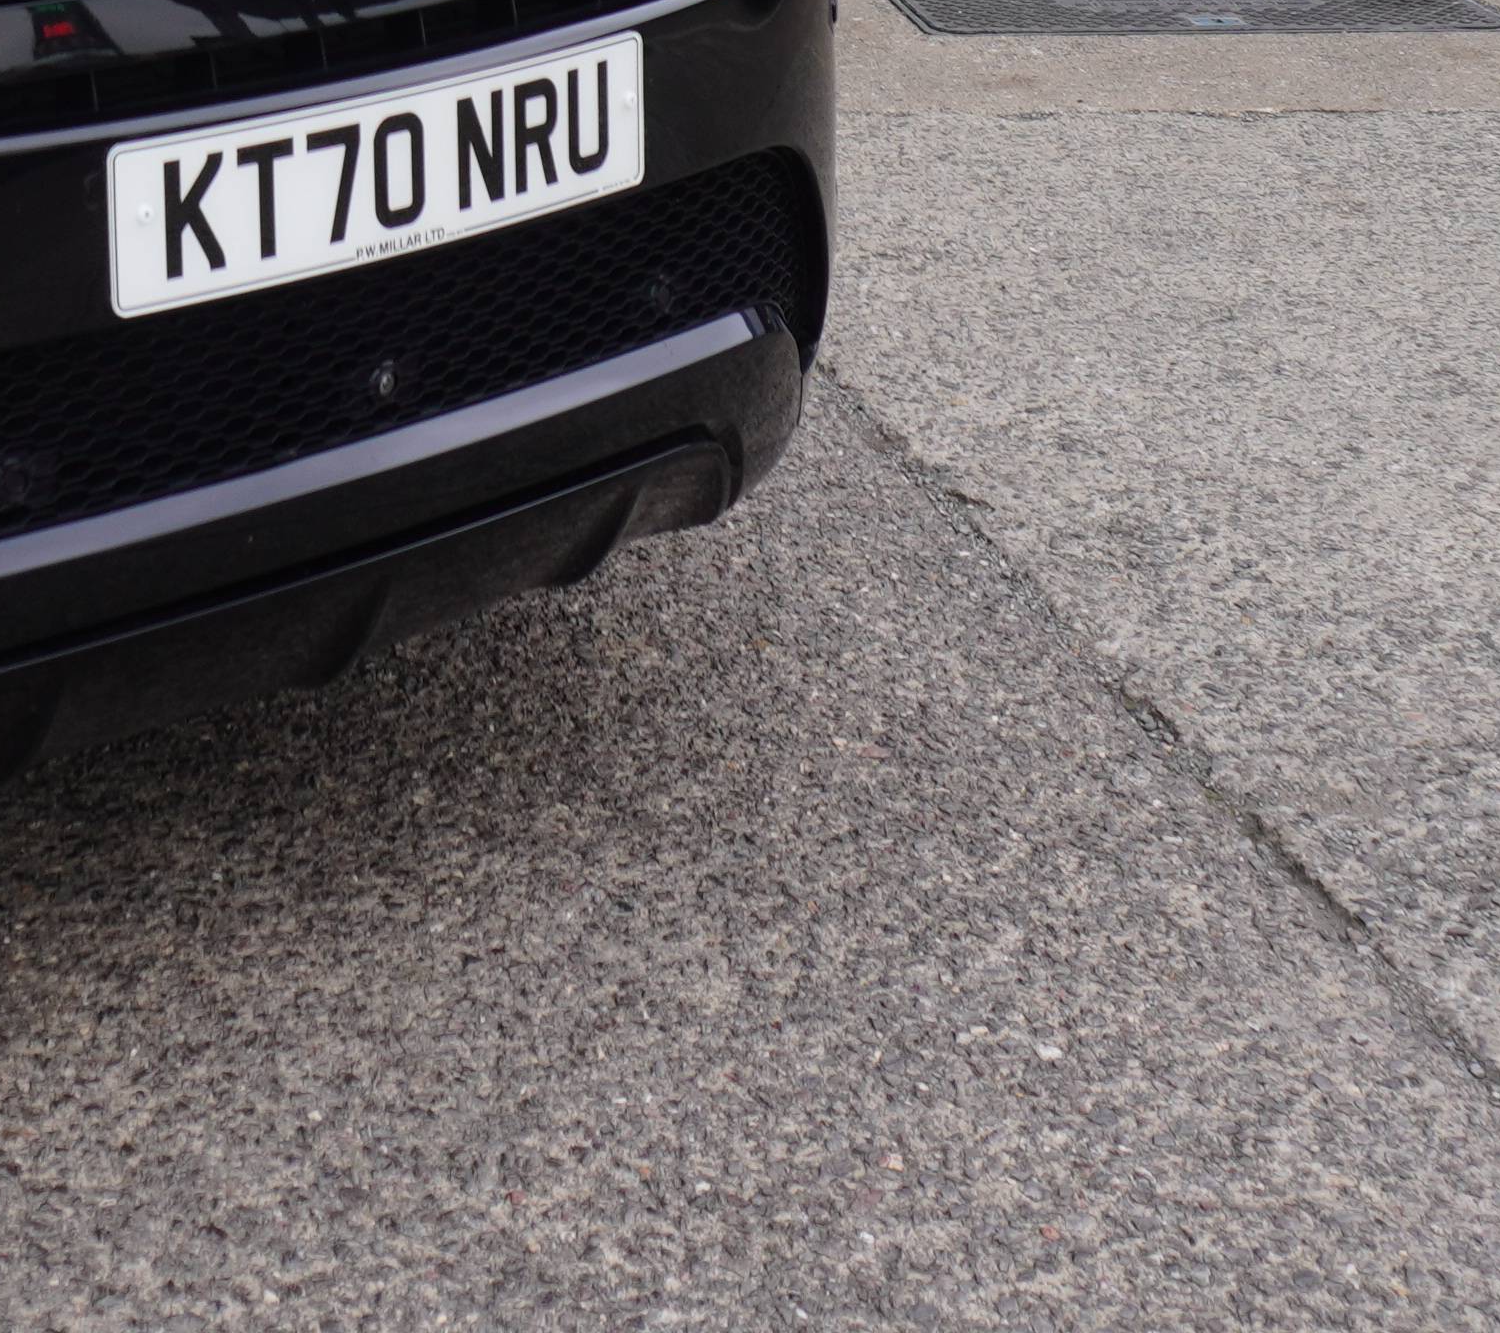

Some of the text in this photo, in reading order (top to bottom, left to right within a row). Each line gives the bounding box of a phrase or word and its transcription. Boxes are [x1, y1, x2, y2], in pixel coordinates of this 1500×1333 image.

[163, 60, 609, 281] KT70 NRU
[425, 227, 445, 244] LTD
